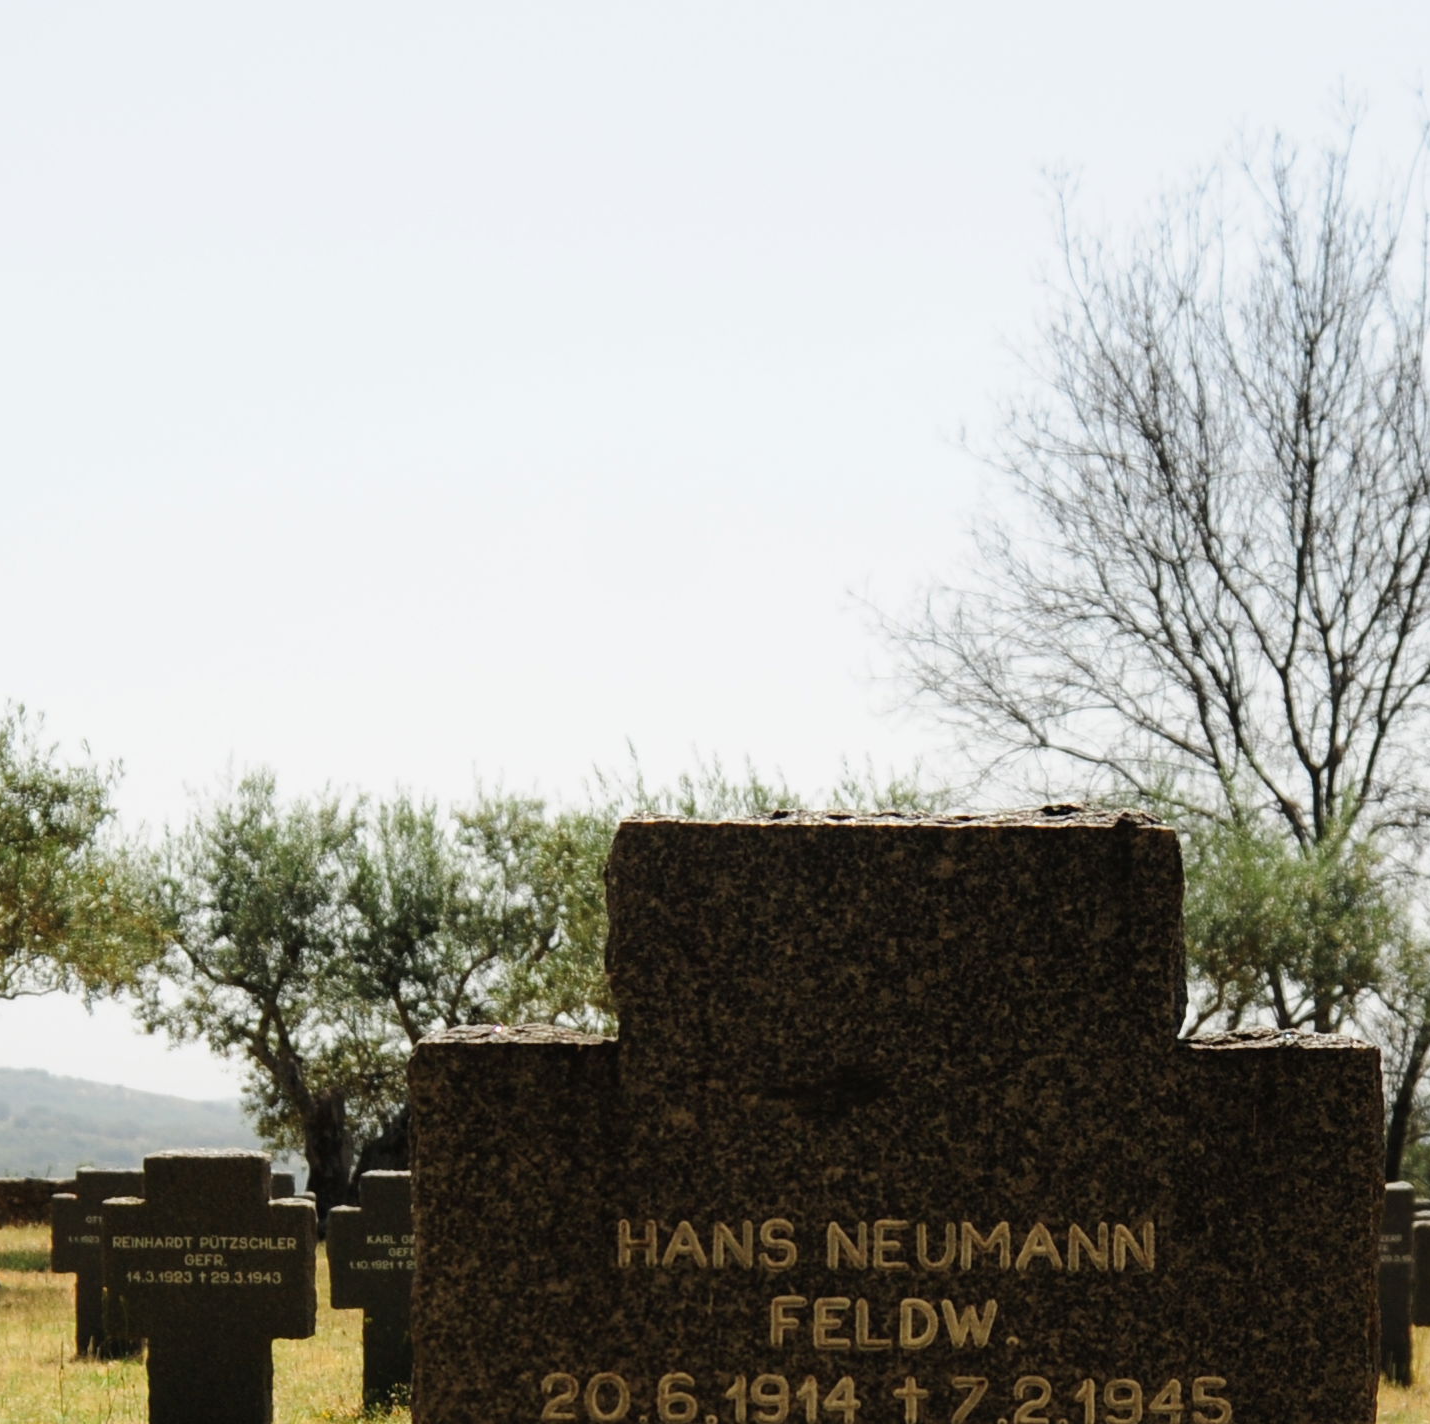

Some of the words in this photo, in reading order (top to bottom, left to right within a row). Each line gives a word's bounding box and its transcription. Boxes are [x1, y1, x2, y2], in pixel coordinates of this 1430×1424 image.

[112, 1236, 193, 1250] REINHARDT
[199, 1234, 298, 1250] PÜTZSCHLER
[366, 1235, 396, 1245] KARL
[617, 1218, 797, 1271] HANS
[827, 1218, 1157, 1272] NEUMANN
[184, 1254, 227, 1267] GEFR.
[126, 1271, 193, 1284] 14.3.1923
[211, 1271, 282, 1285] 29.3.1943
[770, 1296, 1020, 1350] FELDW.
